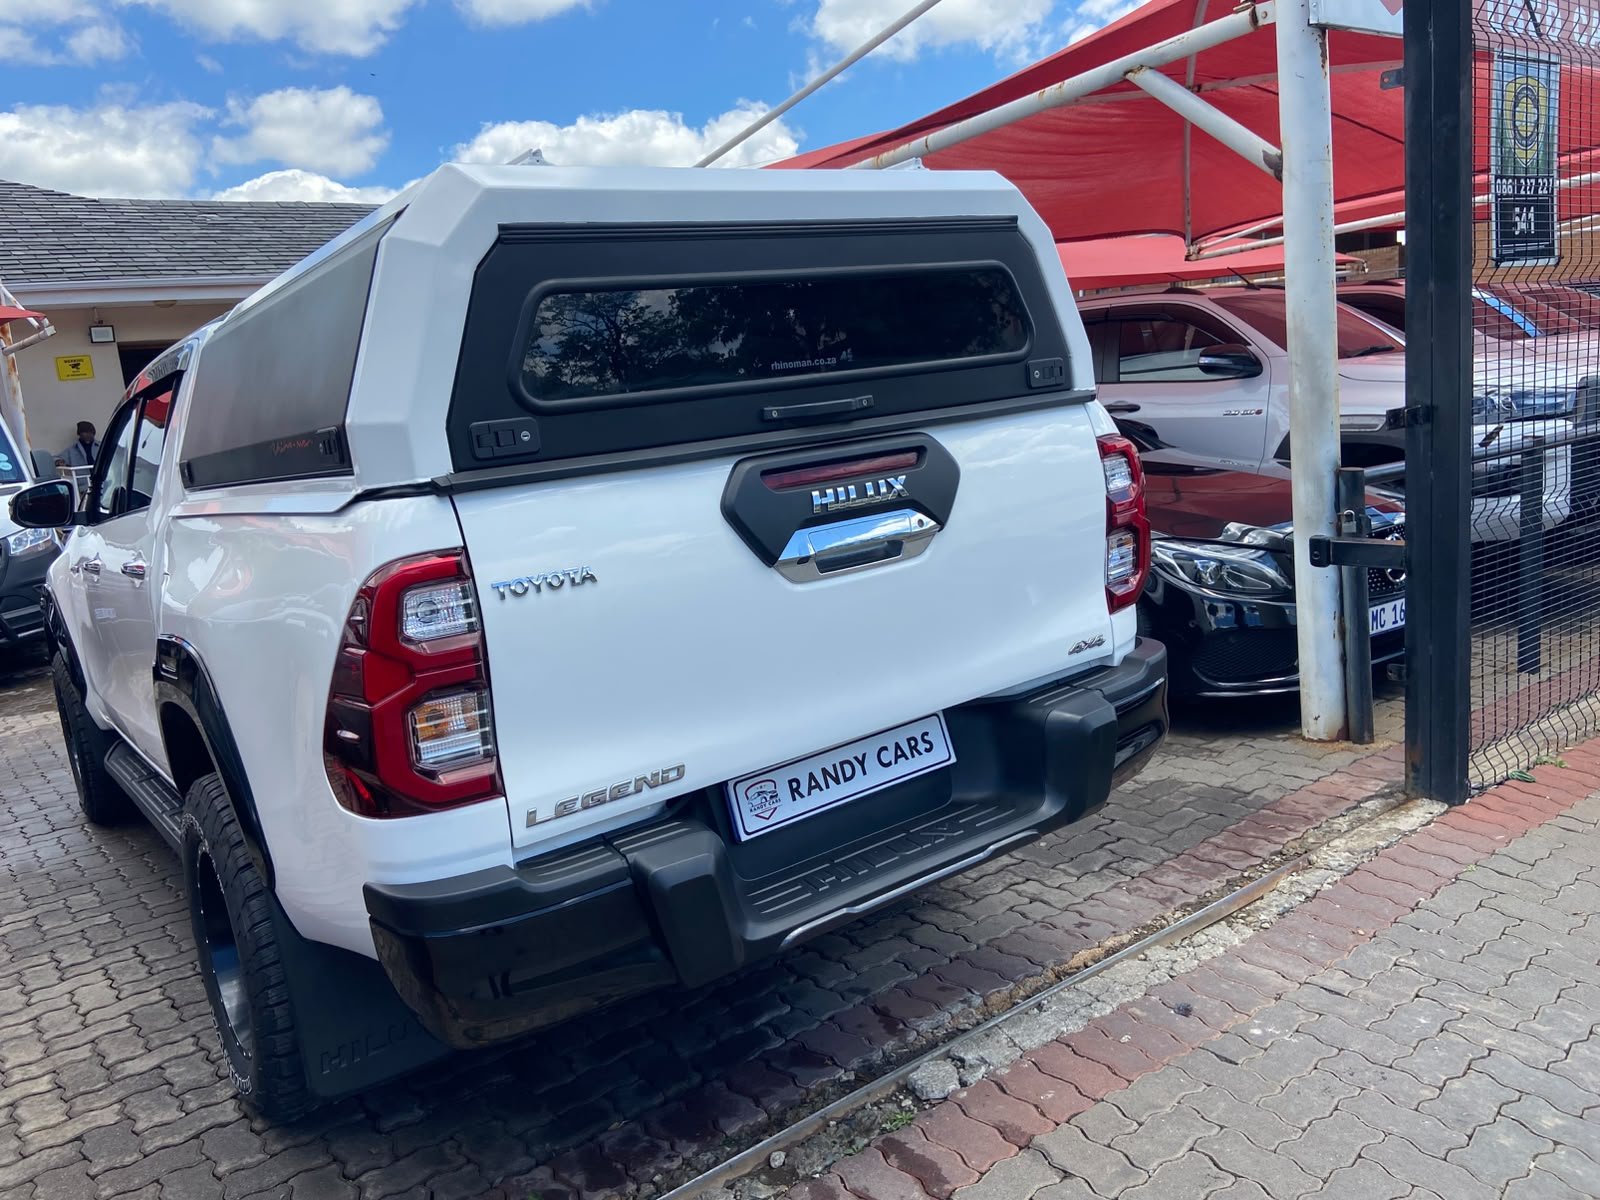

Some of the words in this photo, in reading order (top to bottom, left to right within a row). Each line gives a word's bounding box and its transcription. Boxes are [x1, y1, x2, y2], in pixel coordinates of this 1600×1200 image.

[1496, 178, 1517, 196] 0861
[1511, 205, 1535, 236] 541
[771, 357, 837, 371] rhinoman.co.za
[811, 475, 909, 514] HILUX
[491, 565, 598, 601] TOYOTA
[1371, 607, 1386, 632] MC
[787, 752, 867, 802] RANDY
[876, 731, 934, 768] CARS
[525, 762, 685, 828] LEGEND
[320, 1020, 420, 1075] HILU
